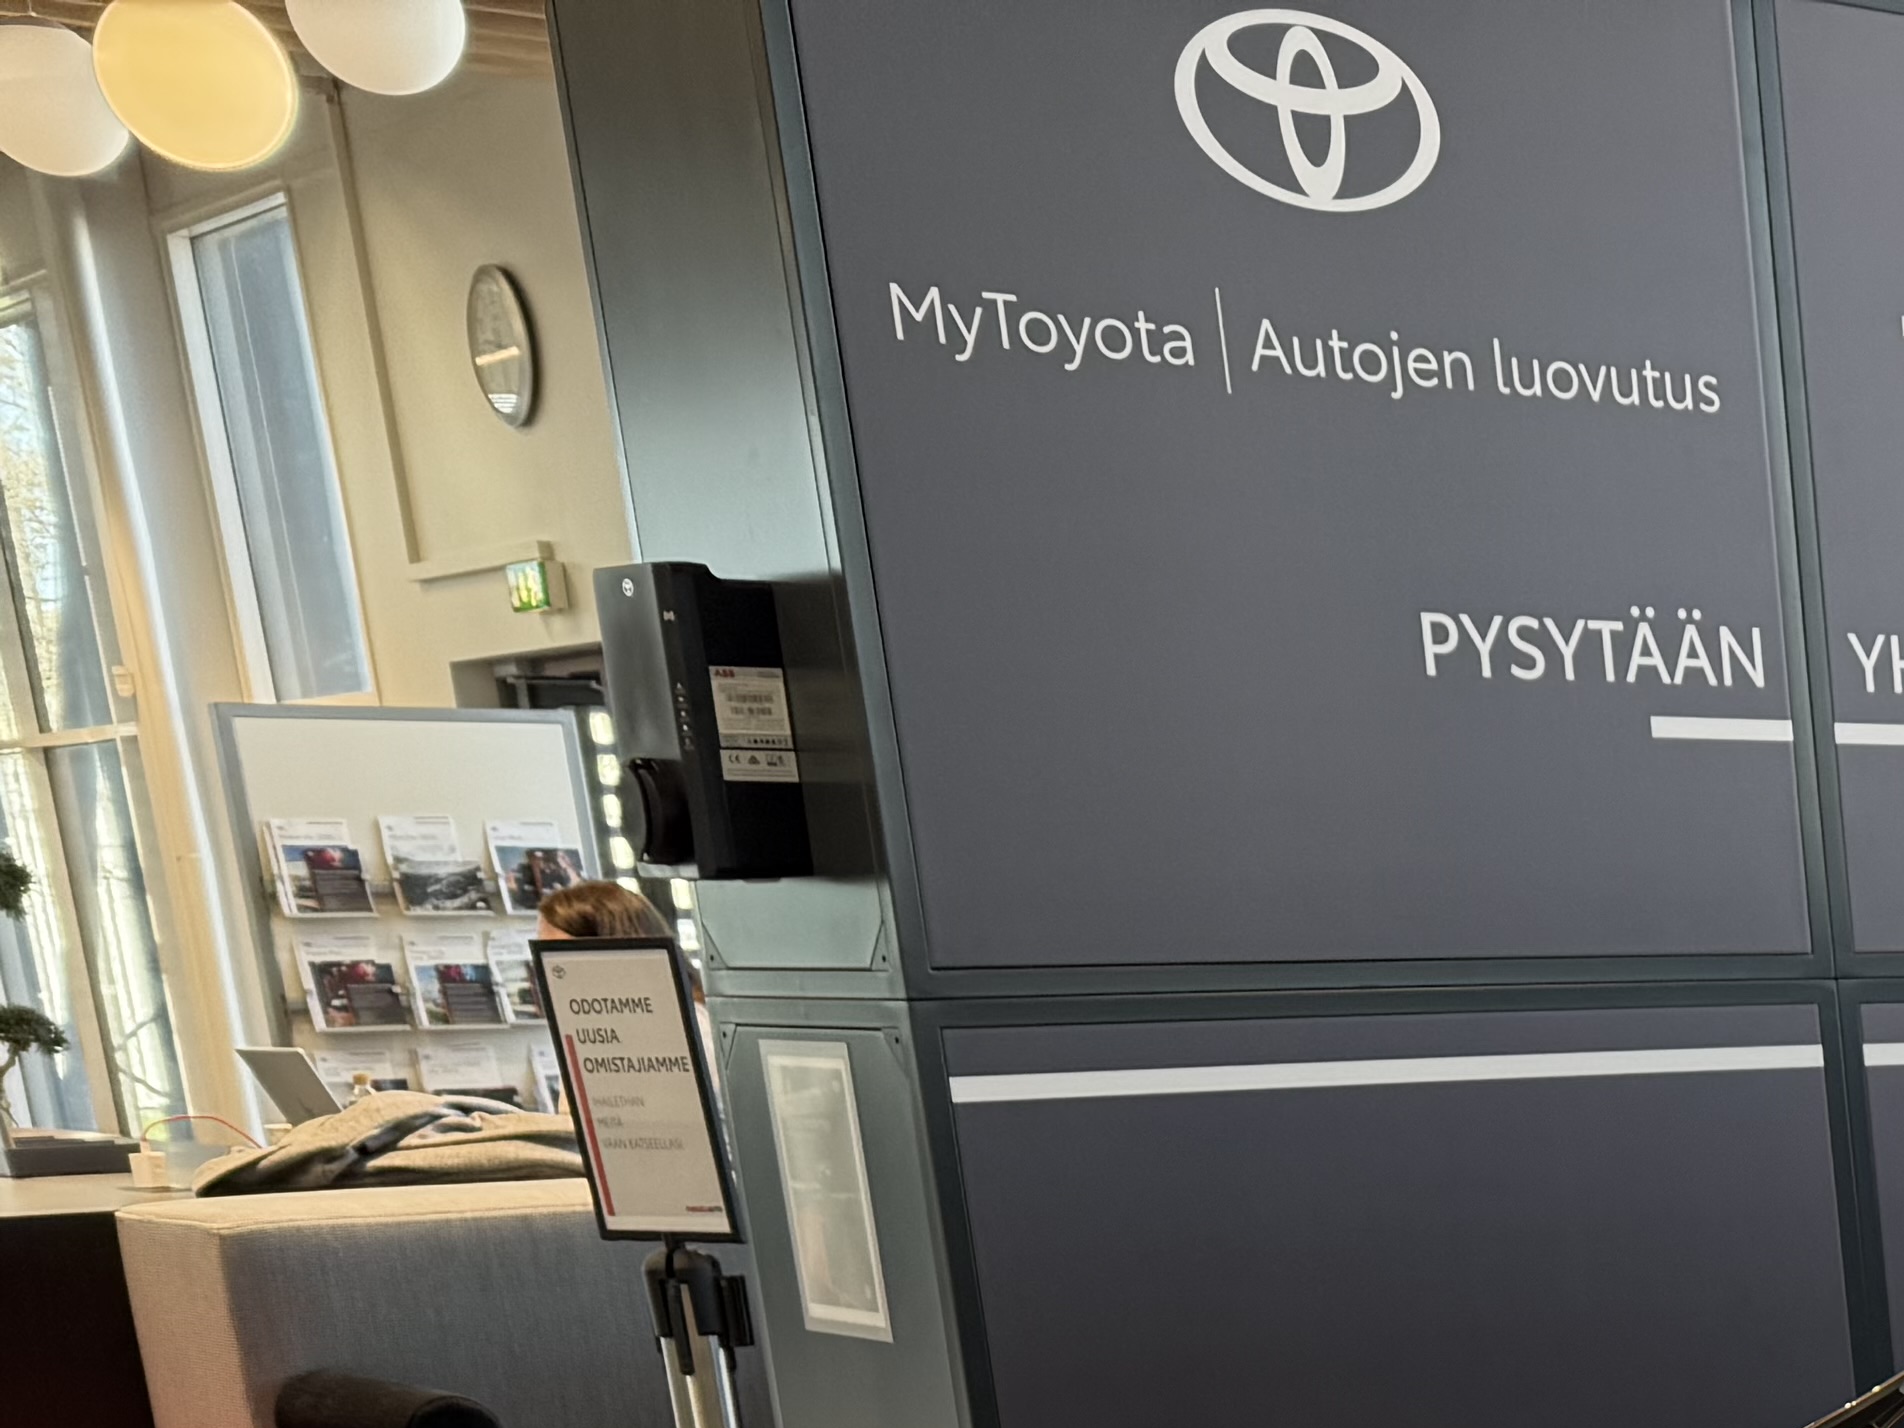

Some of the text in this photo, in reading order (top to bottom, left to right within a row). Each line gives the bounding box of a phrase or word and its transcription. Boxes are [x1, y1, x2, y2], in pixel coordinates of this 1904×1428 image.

[888, 281, 1722, 414] MyToyota Autojen luovutus
[1419, 604, 1766, 689] PYSYTÄÄN
[568, 996, 654, 1015] ODOTAMME
[575, 1027, 621, 1044] UUSIA
[583, 1055, 691, 1074] OMISTAJIAMME
